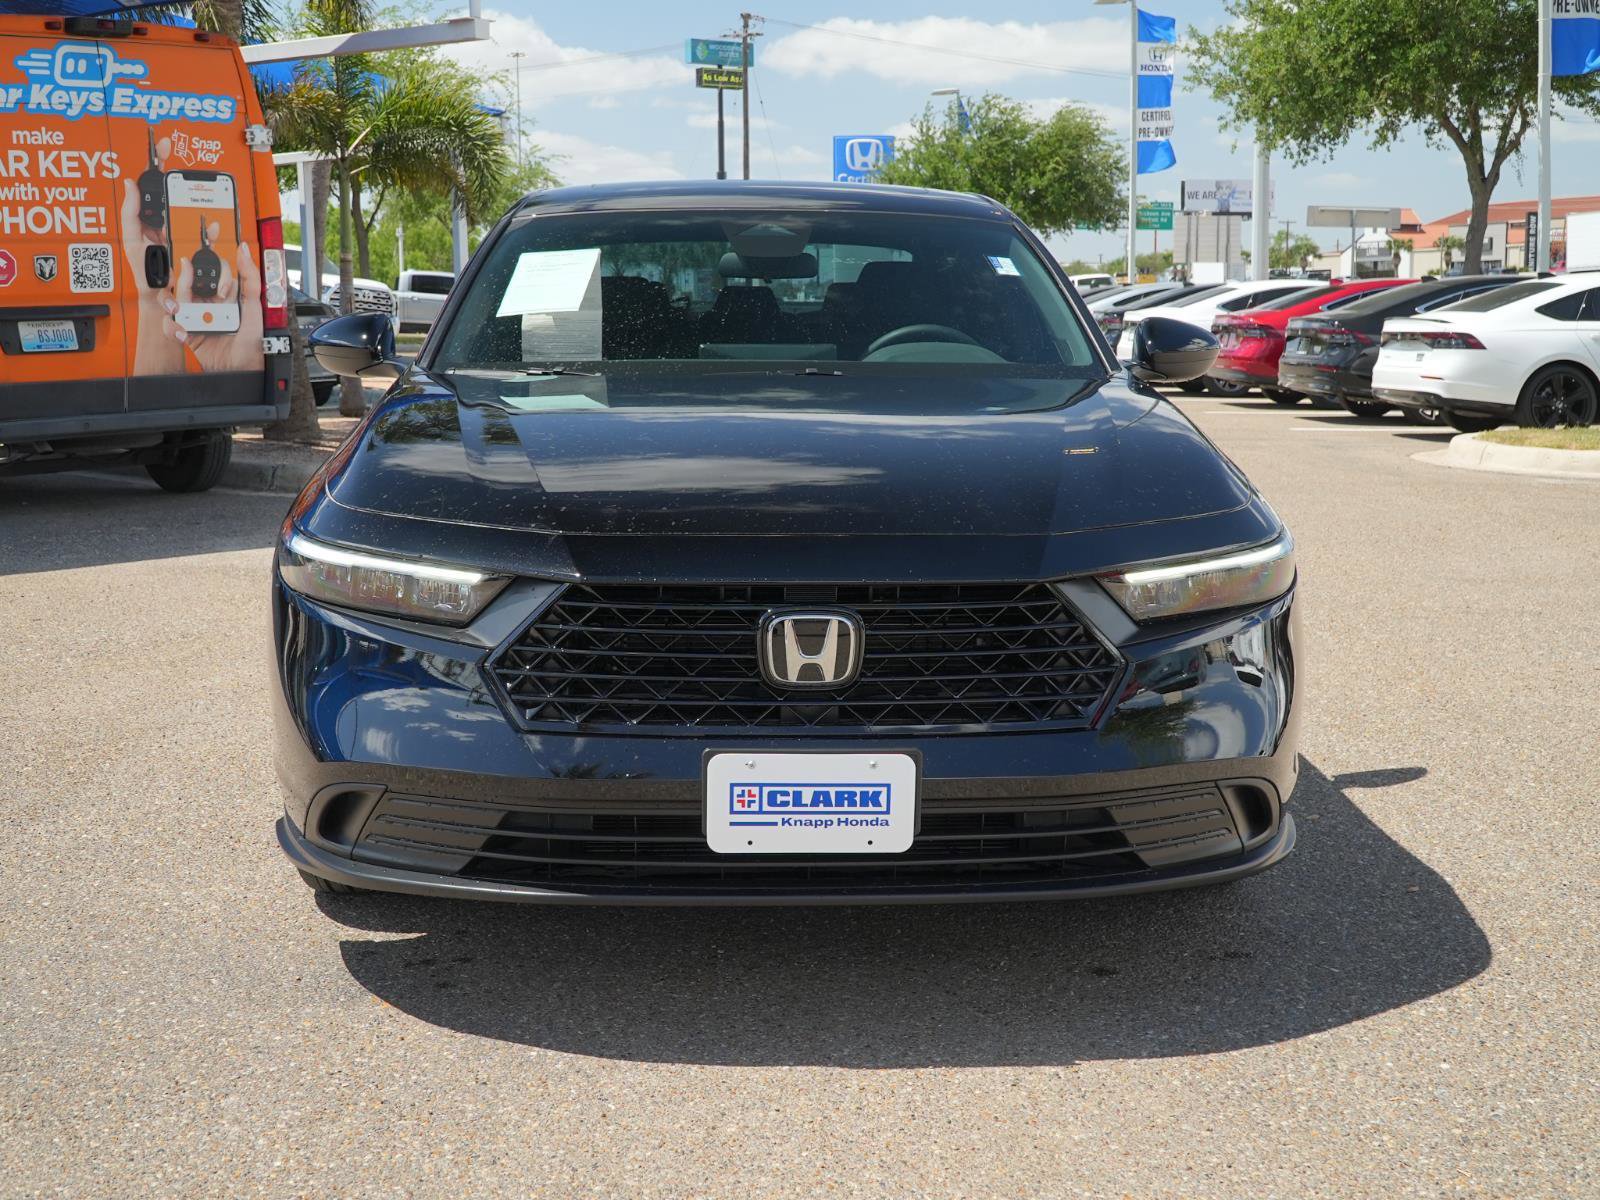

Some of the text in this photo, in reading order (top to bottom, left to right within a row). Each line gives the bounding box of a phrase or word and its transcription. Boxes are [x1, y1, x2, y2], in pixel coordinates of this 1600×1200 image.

[1140, 64, 1172, 72] HONDA
[29, 84, 105, 117] Keys
[110, 87, 233, 120] Express
[12, 127, 65, 145] make
[191, 136, 222, 152] Snap
[38, 150, 121, 179] KEYS
[0, 183, 88, 205] with your
[1187, 191, 1218, 200] WE ARE
[0, 206, 108, 235] HONE!
[766, 790, 883, 808] CLARK
[781, 817, 890, 829] Knapp Honda
